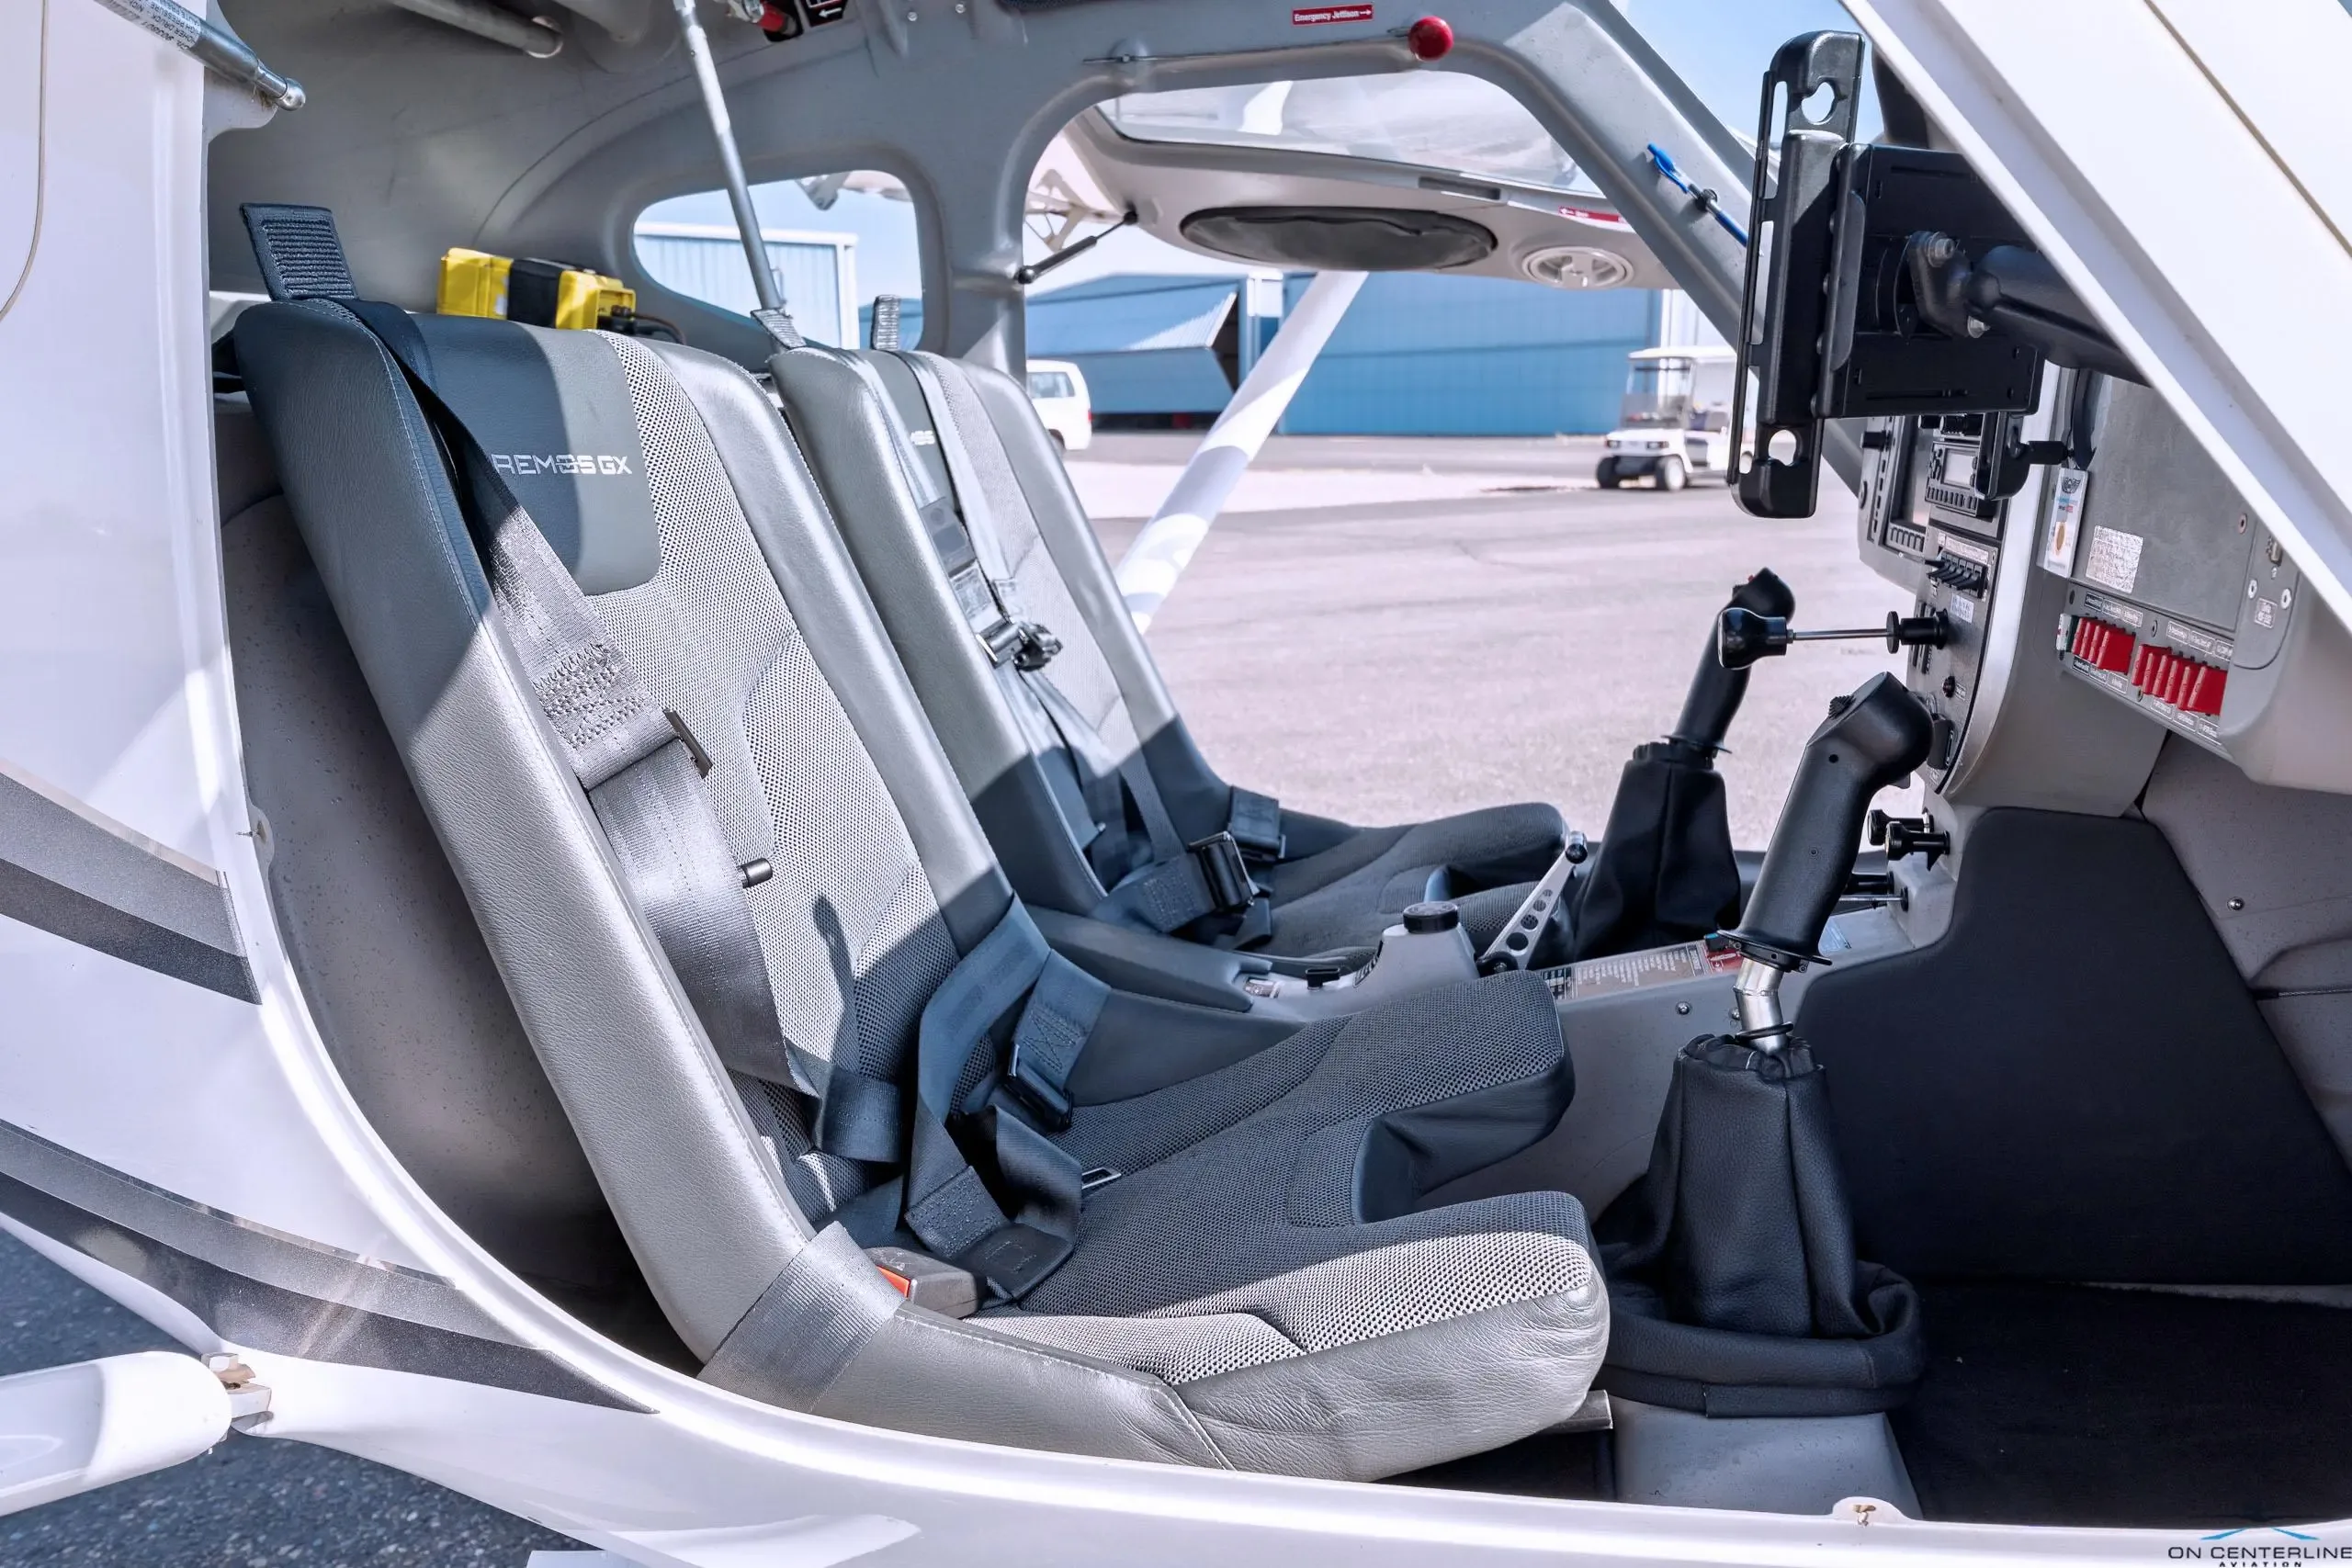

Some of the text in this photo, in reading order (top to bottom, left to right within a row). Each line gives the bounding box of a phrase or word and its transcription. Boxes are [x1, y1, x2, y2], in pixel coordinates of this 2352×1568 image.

[151, 3, 186, 28] PRESSURE
[152, 14, 175, 31] DRUCK
[491, 454, 632, 475] REMOS GX
